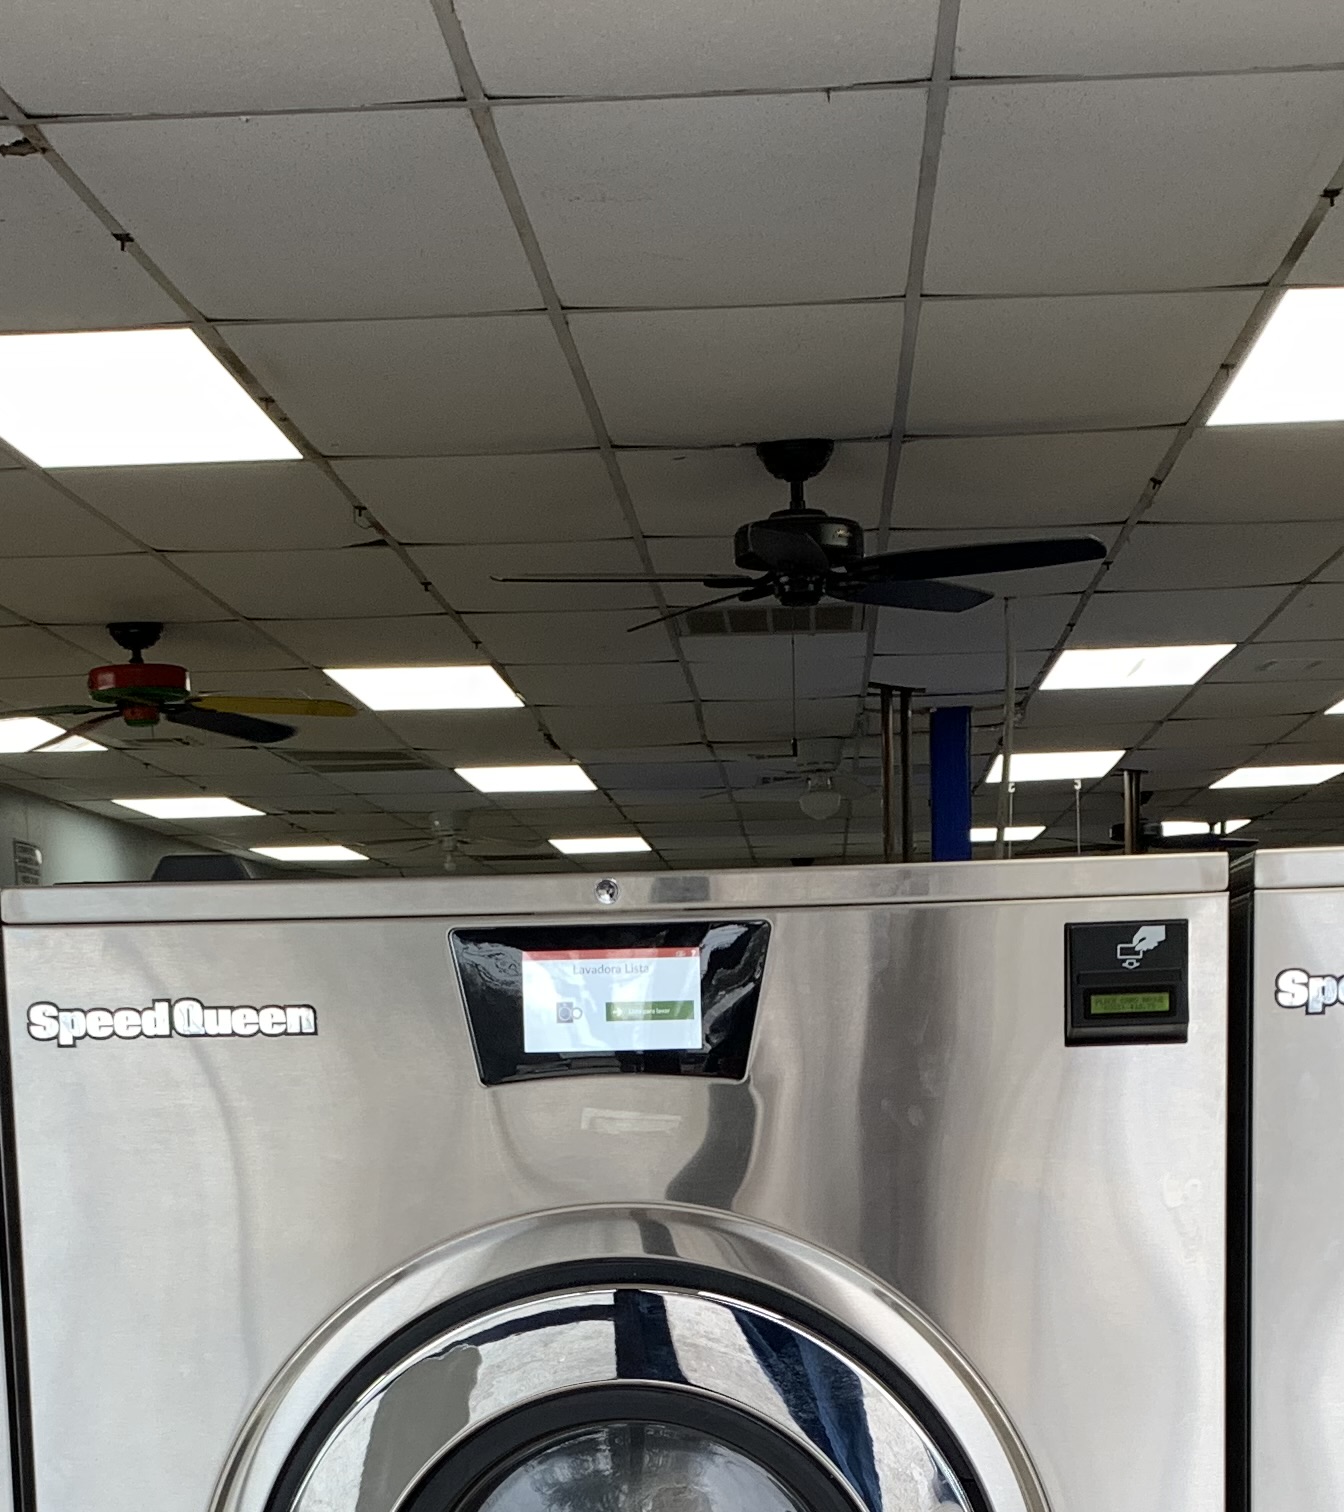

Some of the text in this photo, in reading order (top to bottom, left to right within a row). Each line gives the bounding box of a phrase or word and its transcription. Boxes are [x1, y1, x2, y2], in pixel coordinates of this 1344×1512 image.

[572, 963, 649, 975] Lavadora Lista
[27, 997, 318, 1048] Speed Queen
